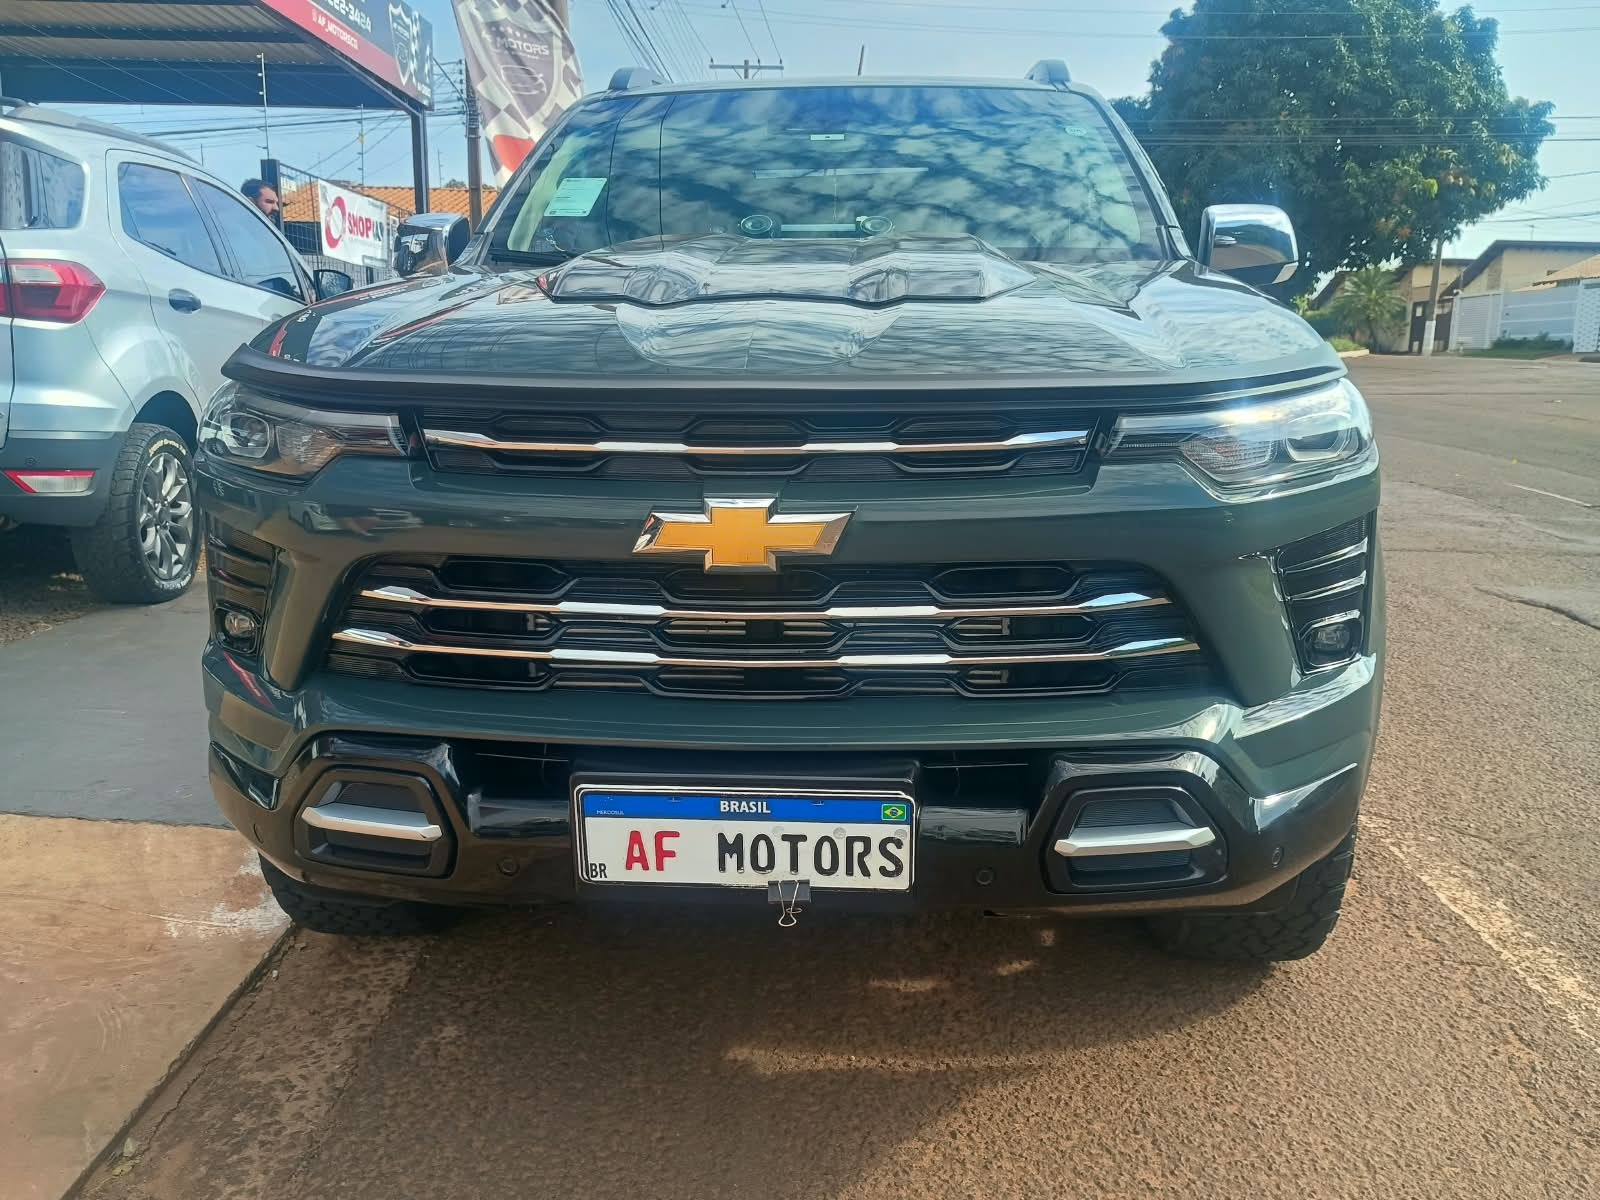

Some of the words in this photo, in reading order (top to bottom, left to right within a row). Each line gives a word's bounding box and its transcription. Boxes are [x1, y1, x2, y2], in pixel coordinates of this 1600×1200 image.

[720, 800, 771, 813] BRASIL
[625, 830, 681, 872] AF
[717, 832, 904, 879] MOTORS
[589, 862, 608, 879] BR
